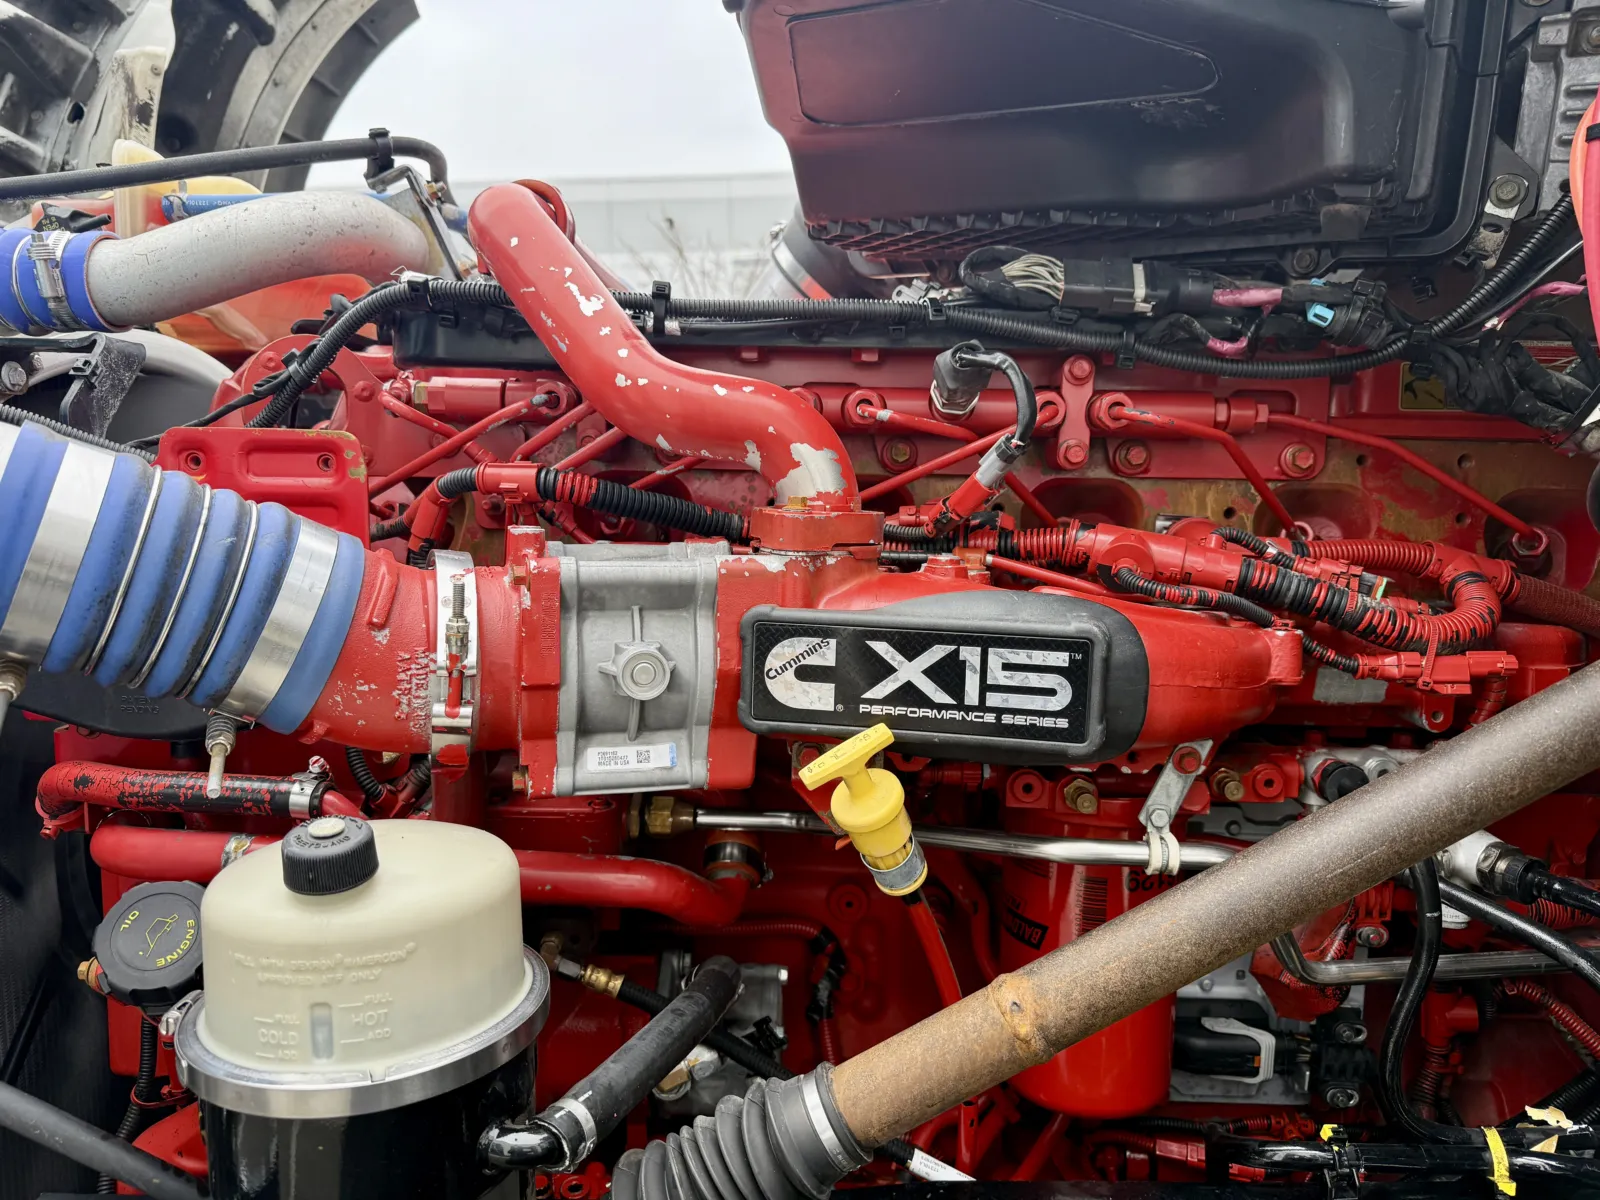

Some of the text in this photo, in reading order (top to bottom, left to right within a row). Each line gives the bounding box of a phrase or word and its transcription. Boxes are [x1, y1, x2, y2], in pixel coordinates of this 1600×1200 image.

[765, 637, 831, 681] Cummins
[860, 640, 1073, 711] X15
[859, 704, 1069, 729] PERFORMANCE SERIES
[120, 910, 140, 932] OIL
[156, 919, 195, 967] ENGINE
[350, 967, 382, 982] ONLY
[351, 1008, 388, 1026] HOT
[257, 1027, 299, 1046] COLD
[367, 1027, 392, 1041] ADD
[278, 1049, 297, 1061] ADD
